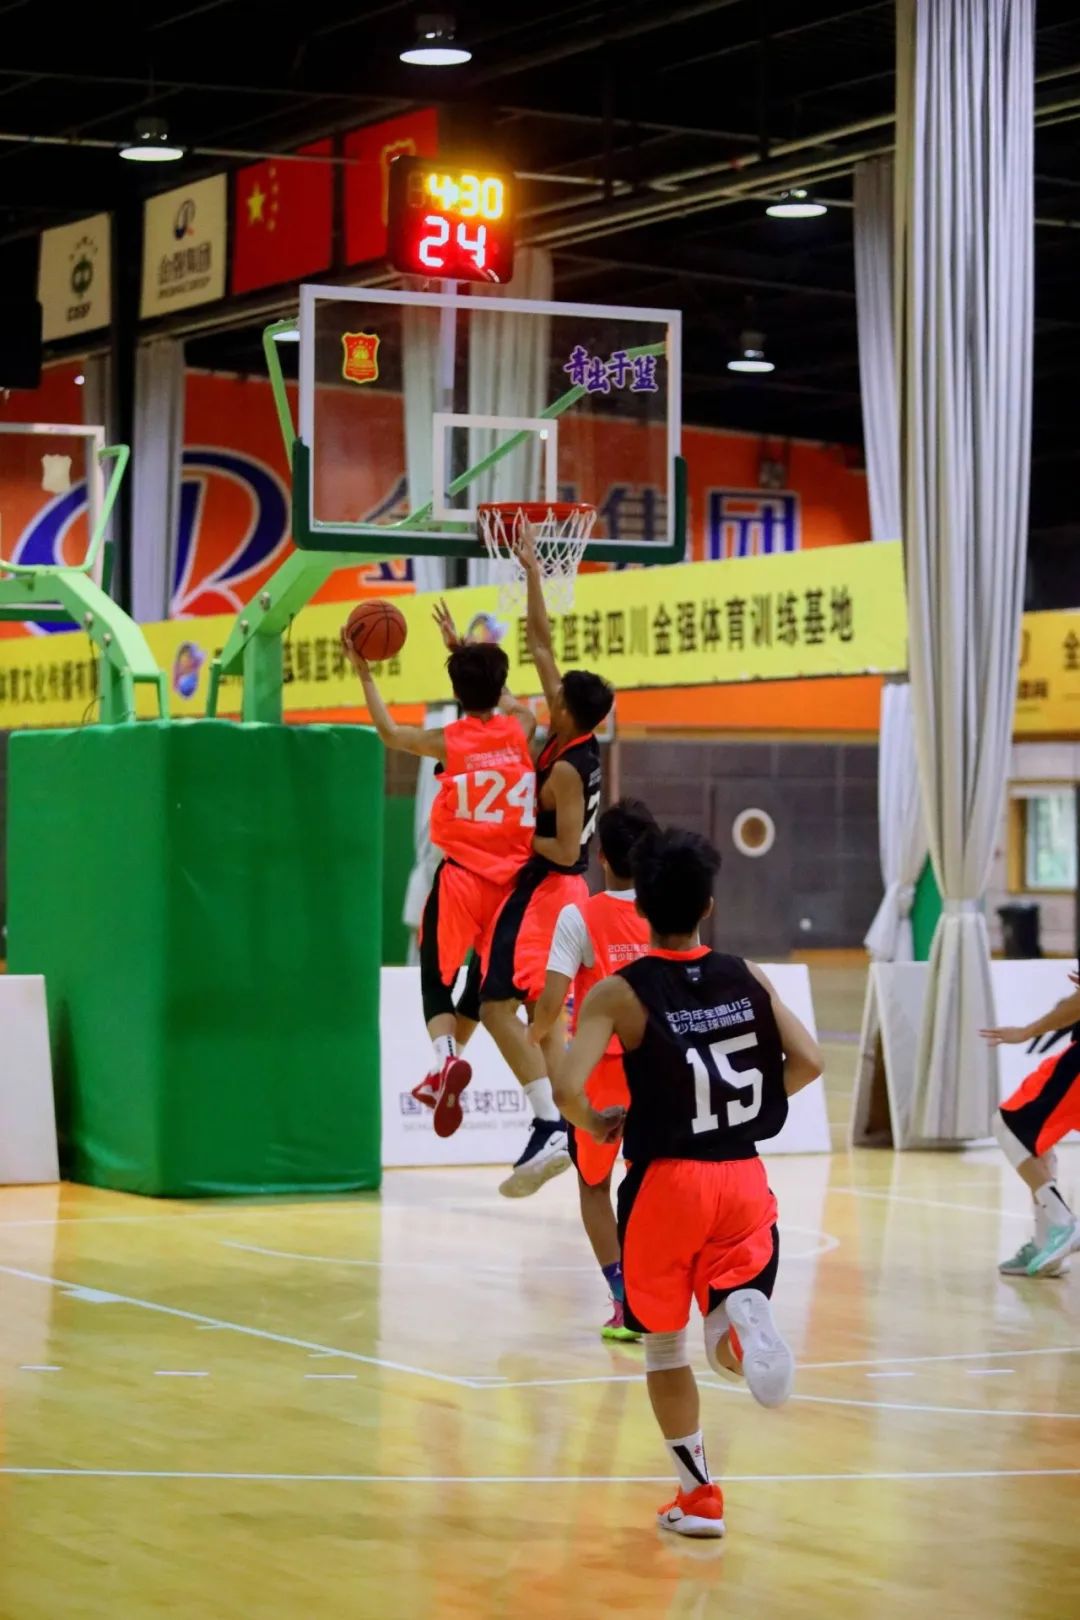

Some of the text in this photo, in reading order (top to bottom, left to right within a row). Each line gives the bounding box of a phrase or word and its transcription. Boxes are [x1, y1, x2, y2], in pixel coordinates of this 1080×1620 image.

[419, 214, 487, 269] 24
[453, 770, 537, 828] 124
[686, 1032, 764, 1134] 15
